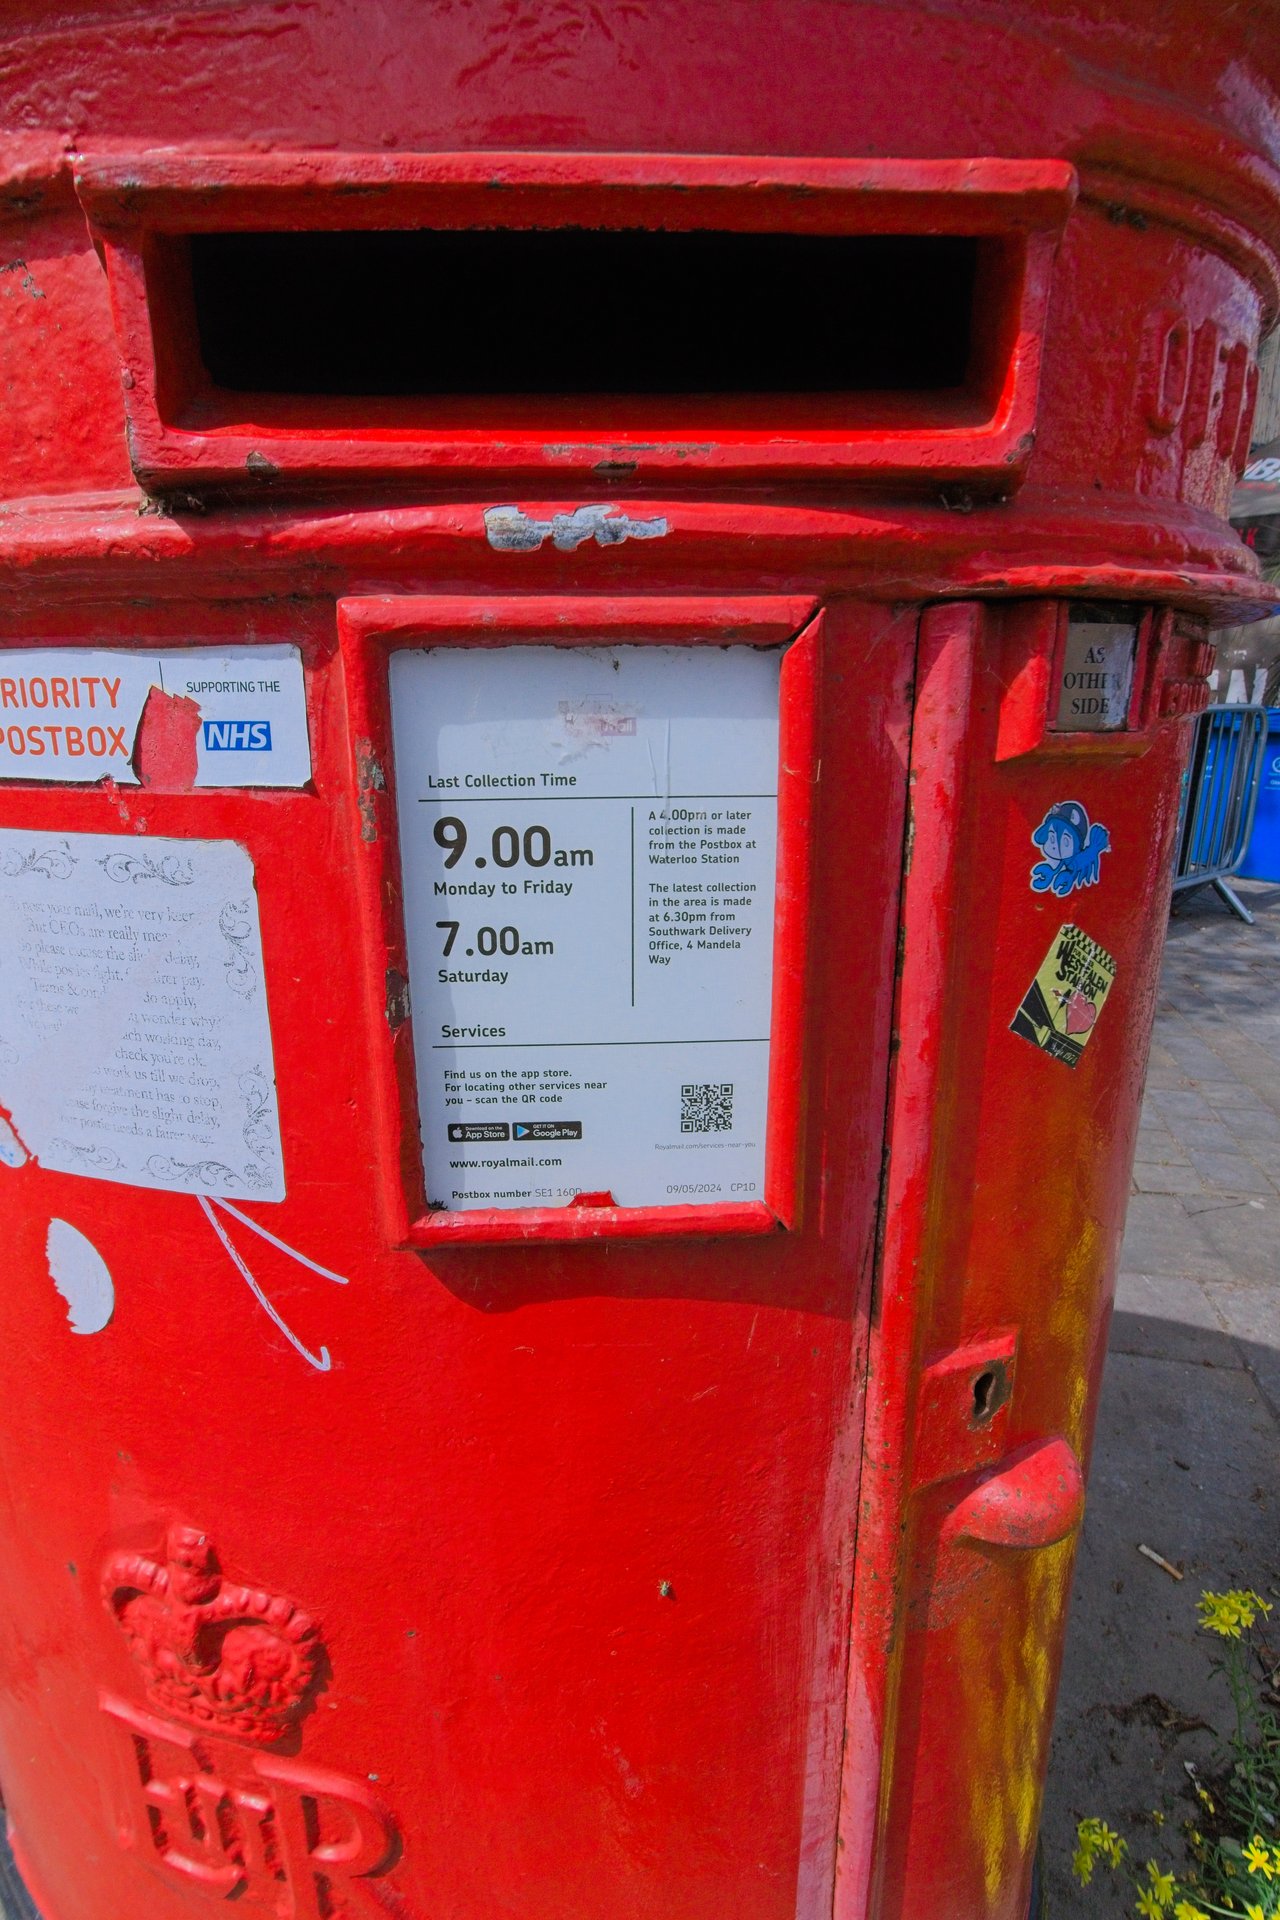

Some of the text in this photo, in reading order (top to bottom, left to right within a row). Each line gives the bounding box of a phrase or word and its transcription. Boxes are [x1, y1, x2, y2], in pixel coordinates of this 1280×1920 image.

[1084, 647, 1105, 663] AS
[186, 681, 281, 693] SUPPORTING THE
[1071, 697, 1110, 715] SIDE
[207, 723, 267, 749] NHS
[428, 773, 577, 788] Last Collection Time
[648, 811, 656, 821] A
[711, 812, 722, 820] or
[726, 810, 752, 820] later
[704, 825, 713, 835] is
[717, 825, 746, 835] made
[433, 816, 594, 870] 9.00am
[649, 839, 757, 849] from the Postbox at
[649, 854, 740, 864] Waterloo Station
[433, 880, 573, 897] Monday to Friday
[649, 882, 757, 893] The latest collection
[649, 896, 752, 907] in the area is made
[137, 909, 165, 925] very
[649, 911, 736, 924] at 6.30pm from
[649, 925, 752, 937] Southwark Delivery
[436, 921, 554, 957] 7.00am
[649, 940, 741, 951] Office, 4 Mandela
[648, 954, 671, 966] Way
[438, 969, 509, 985] Saturday
[441, 1024, 506, 1038] Services
[115, 1046, 148, 1062] check
[444, 1069, 572, 1080] Find us on the app store.
[445, 1081, 608, 1093] For locating other services near
[445, 1097, 464, 1107] you
[475, 1096, 498, 1104] scan
[501, 1095, 518, 1104] the
[521, 1095, 536, 1104] QR
[539, 1094, 563, 1103] code
[465, 1130, 506, 1140] App Store
[532, 1128, 578, 1138] Google Play
[449, 1157, 562, 1169] www.royalmail.com
[451, 1190, 491, 1199] Postbox
[493, 1189, 531, 1198] number
[534, 1188, 553, 1197] SE1
[666, 1183, 756, 1194] 09/05/2024 CP1D
